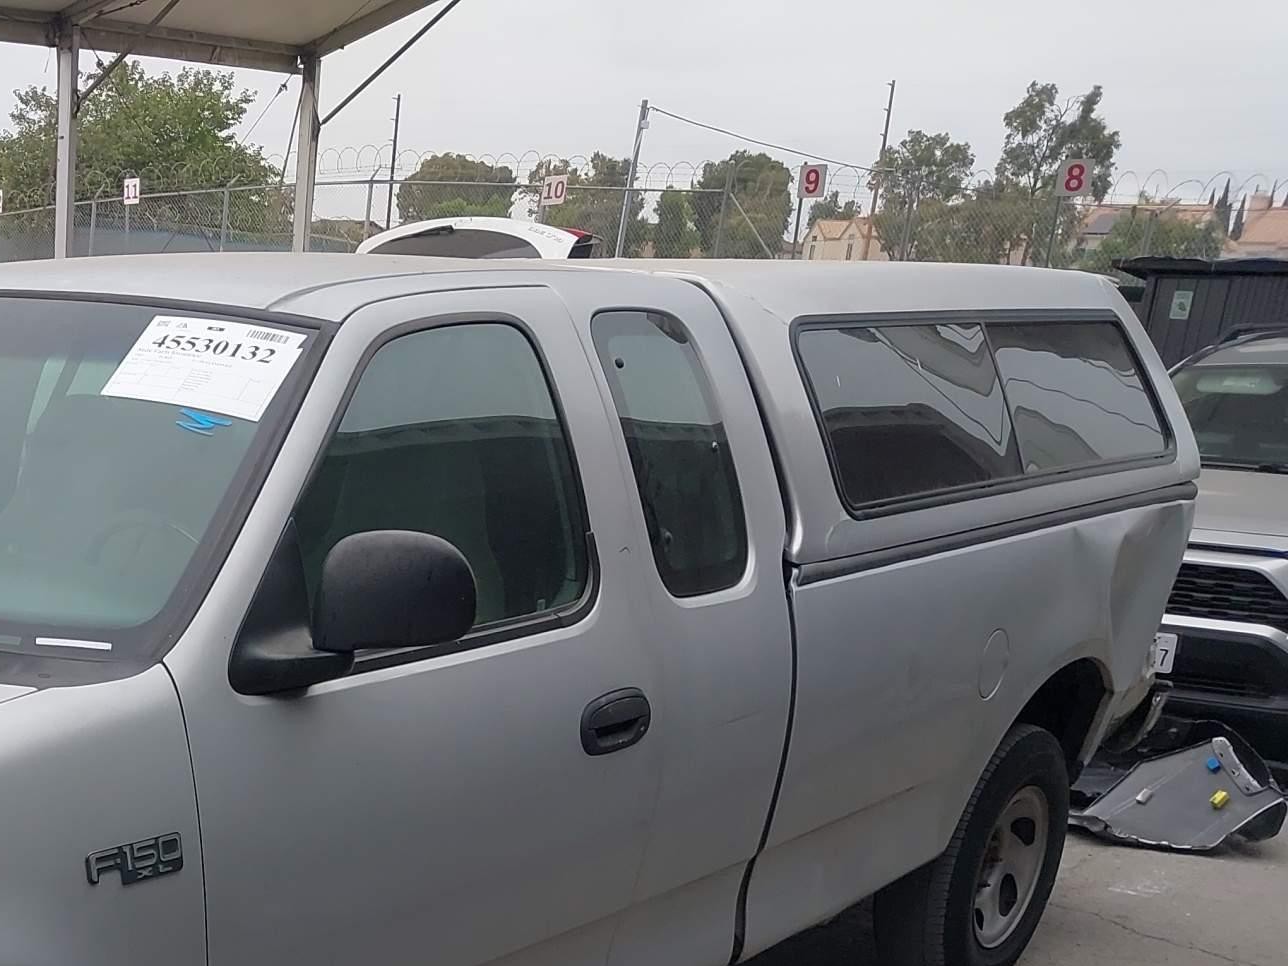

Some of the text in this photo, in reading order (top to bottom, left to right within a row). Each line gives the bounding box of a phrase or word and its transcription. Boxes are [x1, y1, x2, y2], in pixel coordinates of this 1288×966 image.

[804, 168, 820, 194] 9
[1064, 163, 1085, 192] 8
[125, 183, 139, 199] 11
[543, 180, 565, 200] 10
[151, 333, 277, 365] 45530132
[136, 864, 173, 880] XL
